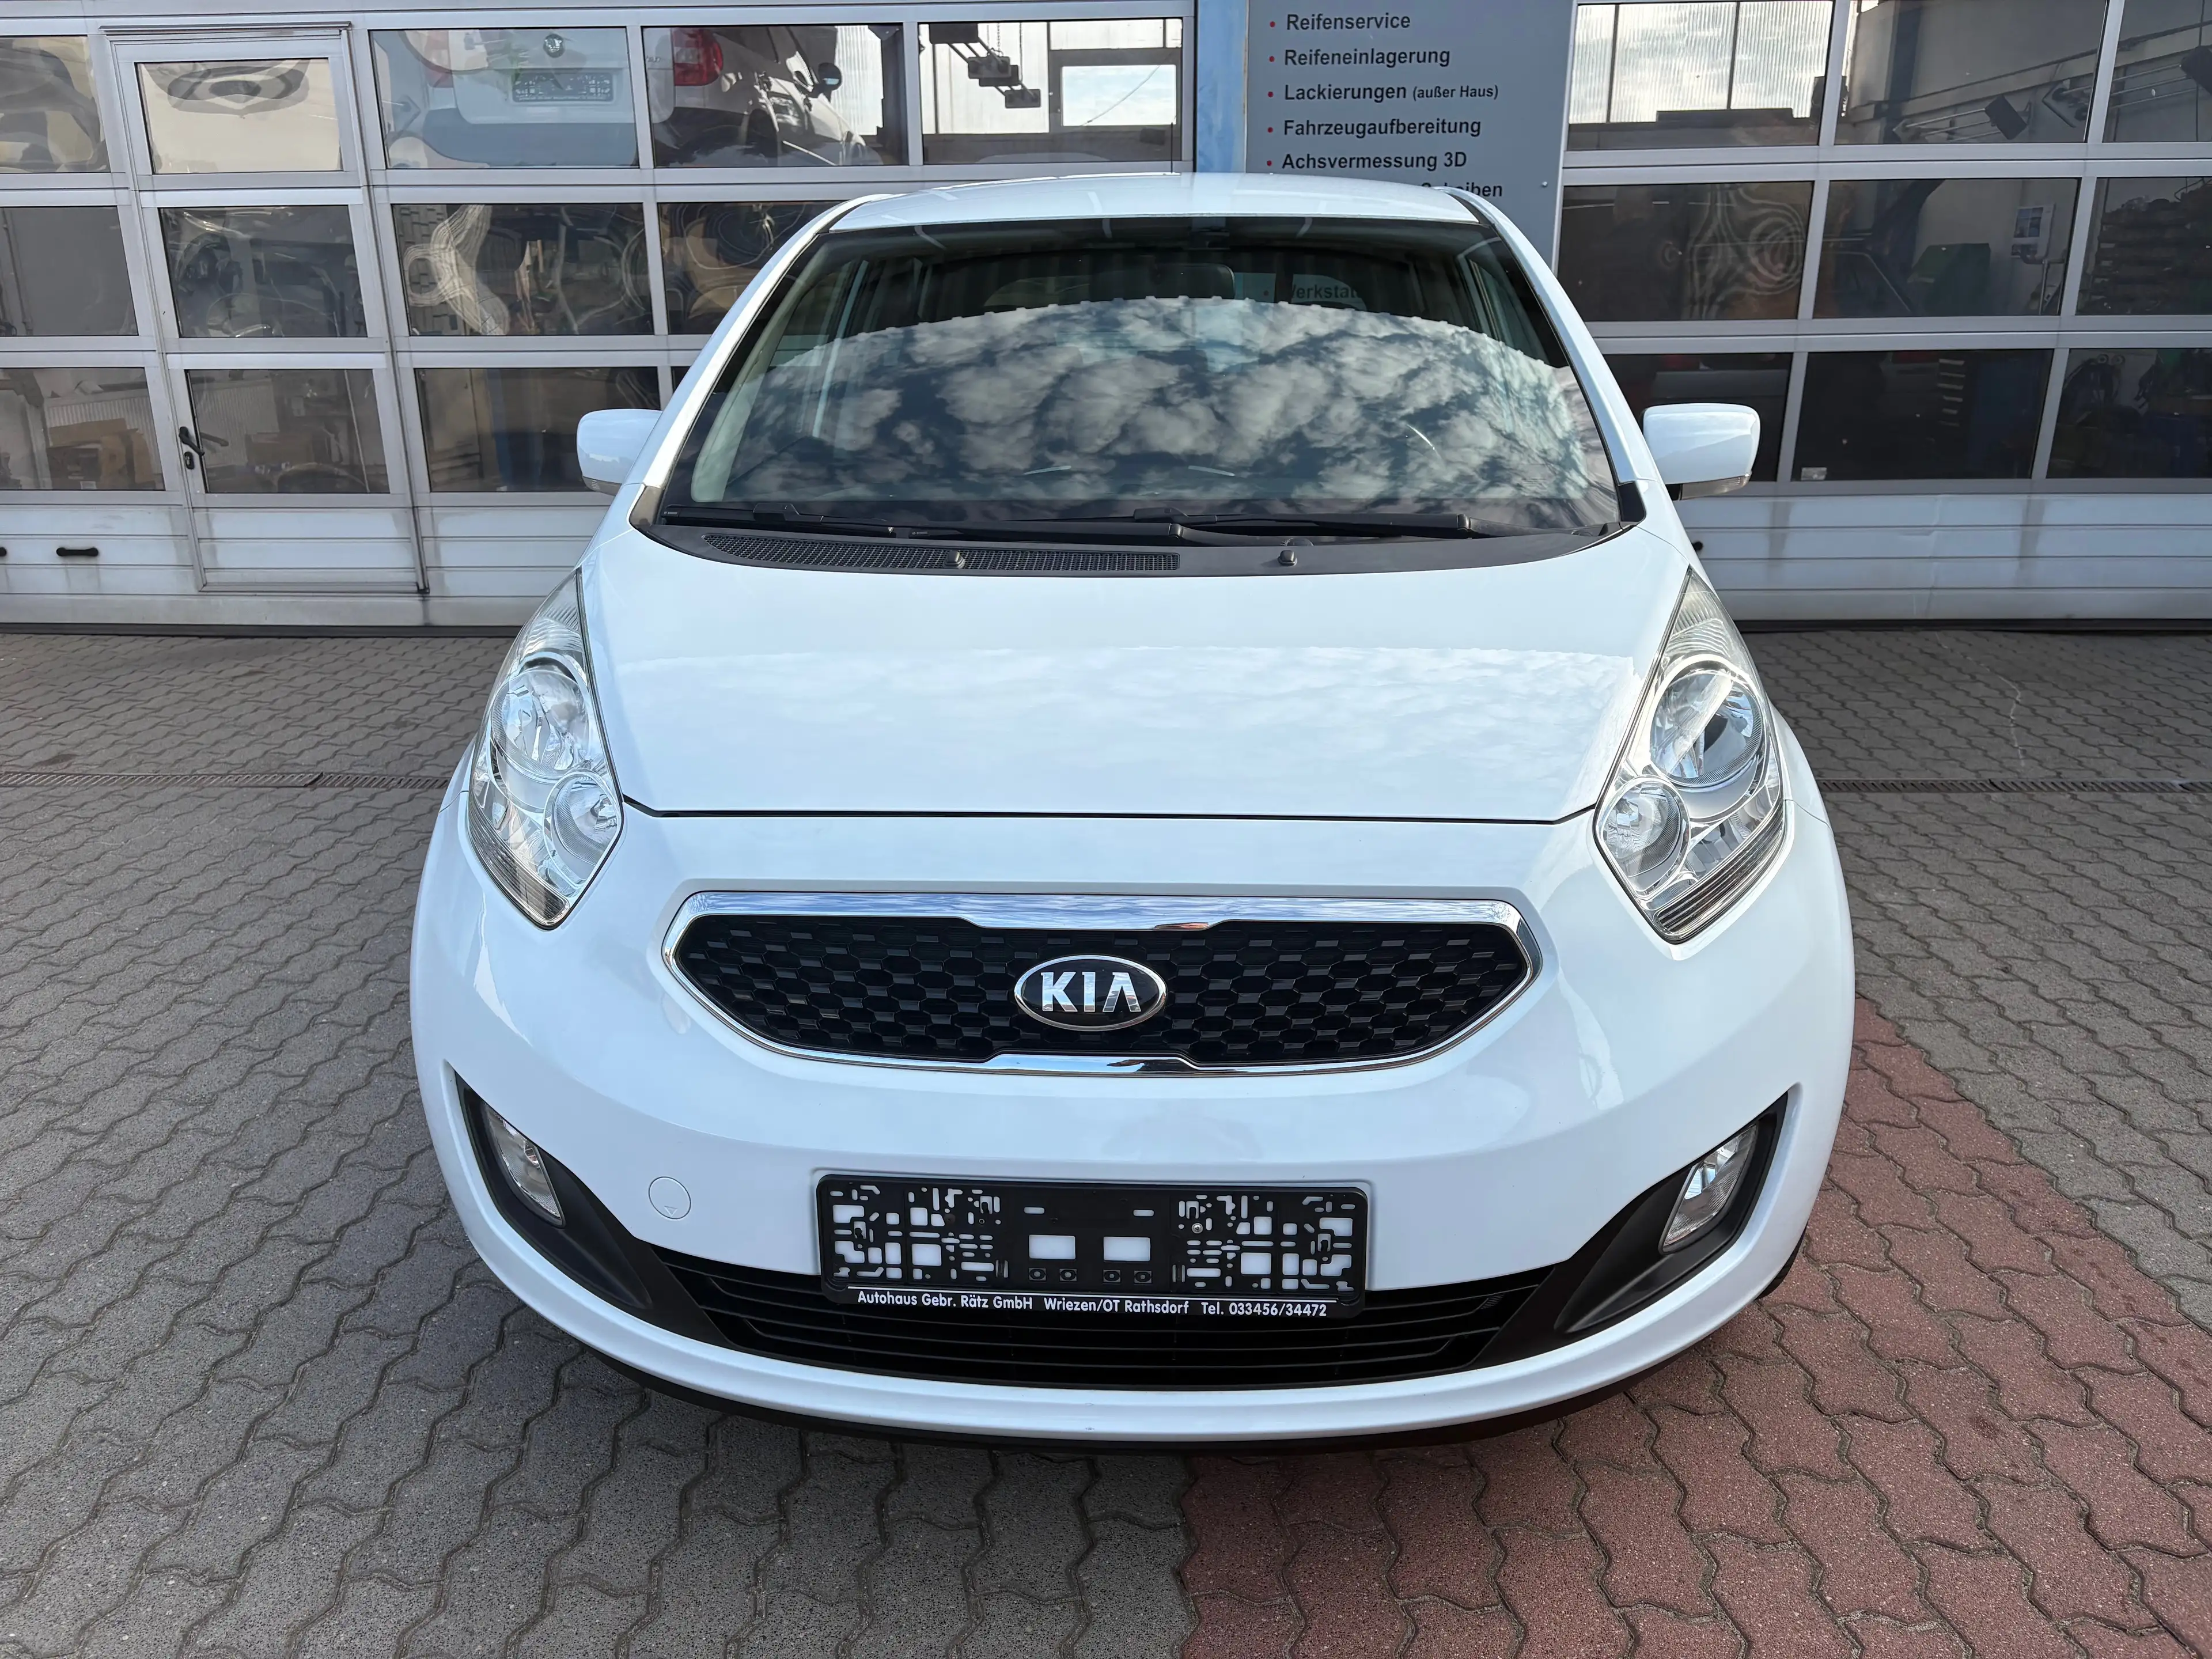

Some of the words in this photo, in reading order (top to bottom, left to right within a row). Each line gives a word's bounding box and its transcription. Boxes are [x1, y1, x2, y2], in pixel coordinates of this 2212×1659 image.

[1286, 12, 1411, 30] Reifenservice
[1284, 48, 1450, 68] Reifeneinlagerung
[1285, 84, 1407, 103] Lackierungen
[1413, 85, 1456, 101] (außer
[1460, 85, 1498, 100] Haus)
[1284, 118, 1481, 139] Fahrzeugaufbereitung
[1282, 153, 1437, 172] Achsvermessung
[1444, 151, 1467, 168] 3D
[1040, 971, 1142, 1013] KIA
[858, 1290, 918, 1305] Autohaus
[921, 1293, 956, 1307] Gebr.
[961, 1294, 989, 1308] Rätz
[993, 1296, 1033, 1309] GmbH
[1043, 1297, 1120, 1312] Wriezen/OT
[1124, 1299, 1190, 1314] Rathsdorf
[1200, 1301, 1225, 1315] Tel.
[1228, 1302, 1327, 1317] 033456/34472
